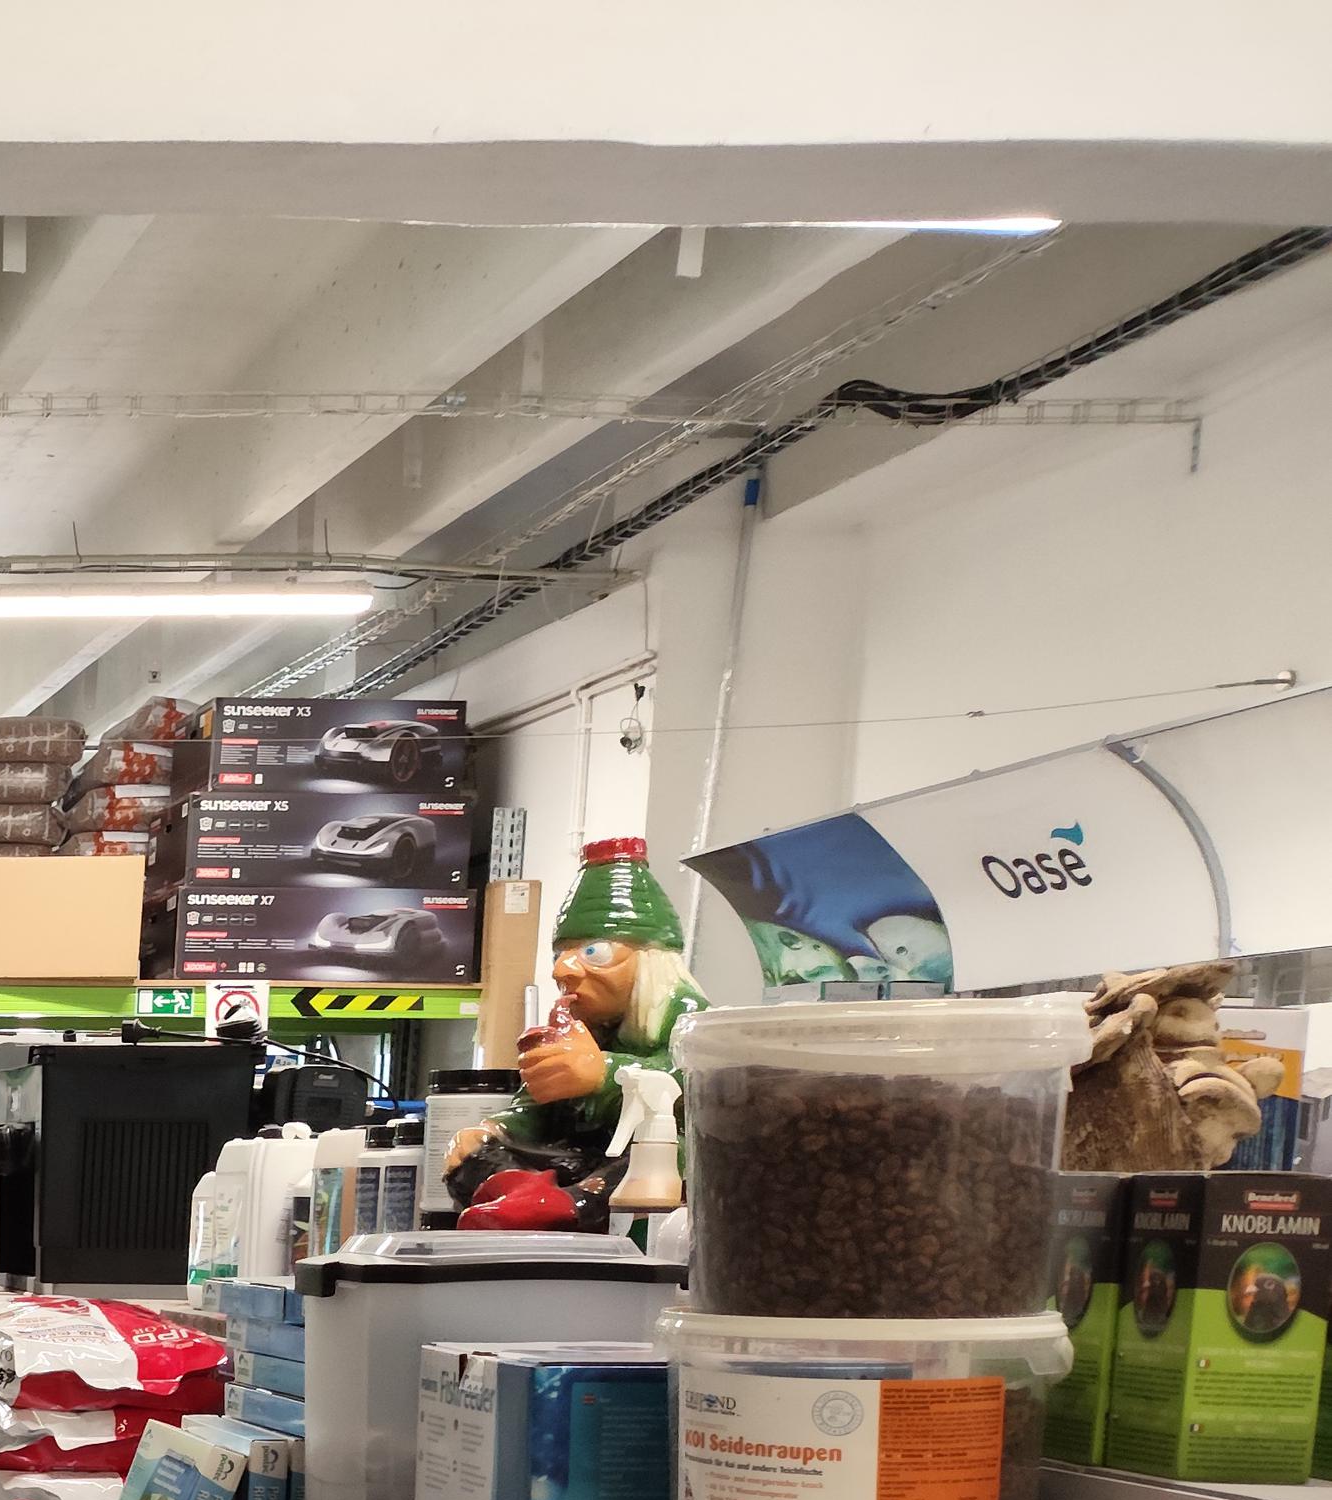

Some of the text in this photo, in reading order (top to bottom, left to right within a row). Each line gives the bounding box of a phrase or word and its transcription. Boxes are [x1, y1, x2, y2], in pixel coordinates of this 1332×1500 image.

[223, 705, 312, 717] sunseeker X3
[200, 800, 289, 811] sunseeker X5
[981, 843, 1093, 899] Oase
[187, 894, 275, 905] sunseeker X7
[1221, 1214, 1321, 1236] KNOBLAMIN
[685, 1429, 842, 1465] KOI Seidenraupen
[213, 1453, 230, 1481] pontec
[261, 1446, 271, 1474] pontec
[737, 1462, 750, 1471] und
[752, 1464, 777, 1474] andere
